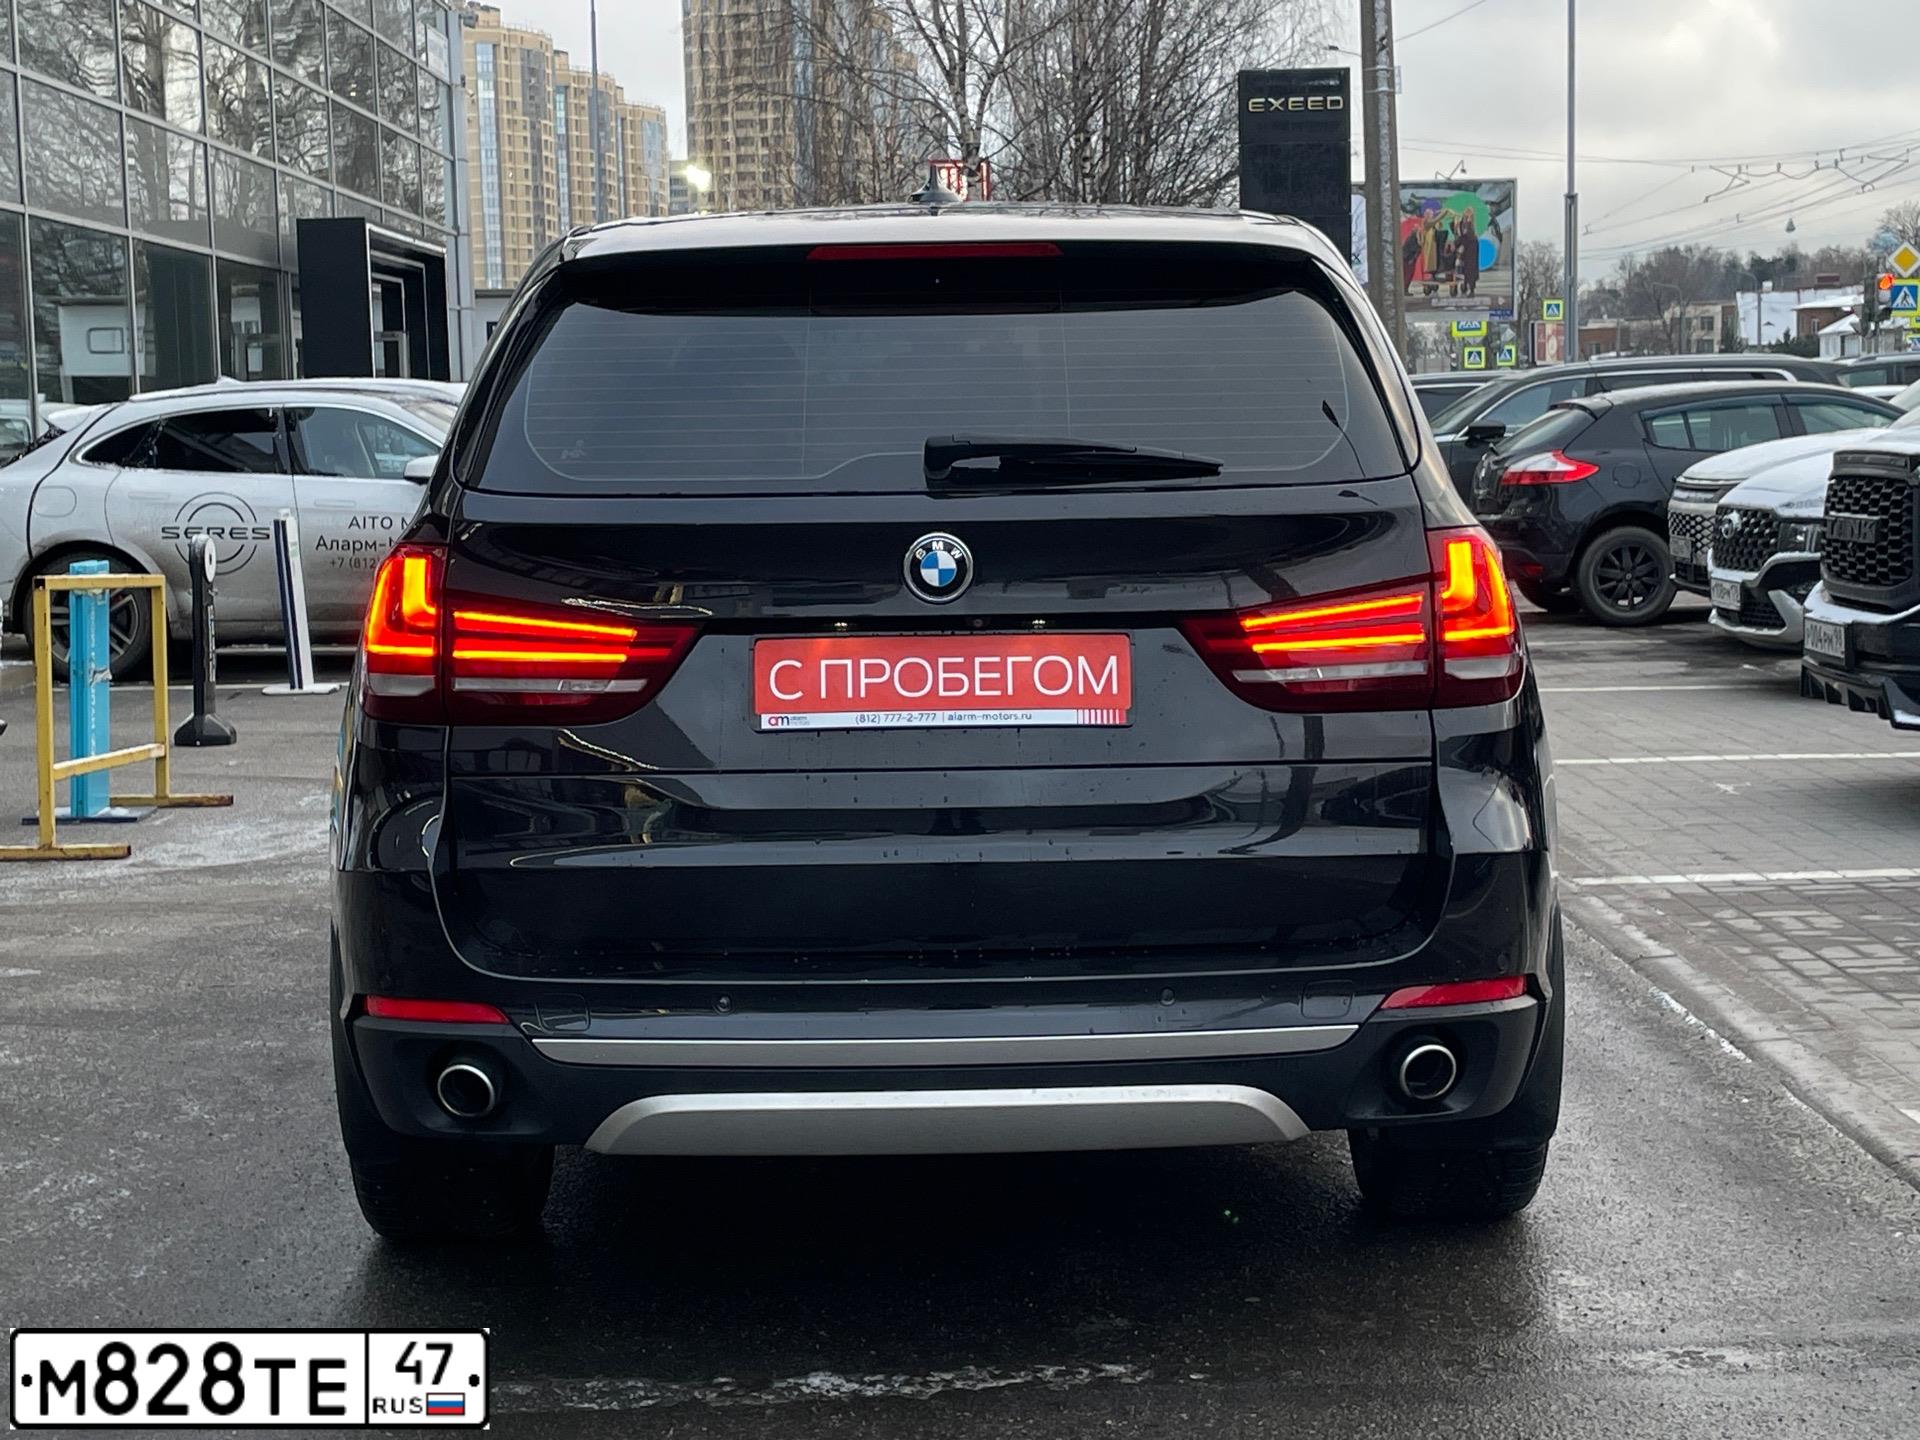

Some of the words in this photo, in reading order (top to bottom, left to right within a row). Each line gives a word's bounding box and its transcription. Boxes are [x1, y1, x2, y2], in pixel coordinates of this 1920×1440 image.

[1248, 96, 1344, 112] EXEED
[348, 515, 393, 530] AITO
[161, 526, 270, 540] SERES
[915, 540, 963, 560] BMW
[768, 659, 803, 700] С
[820, 654, 1119, 699] ПРОБЕГОМ
[855, 713, 881, 725] (812)
[884, 712, 937, 723] 777-2-777
[947, 711, 1033, 721] alarm-motors.ru
